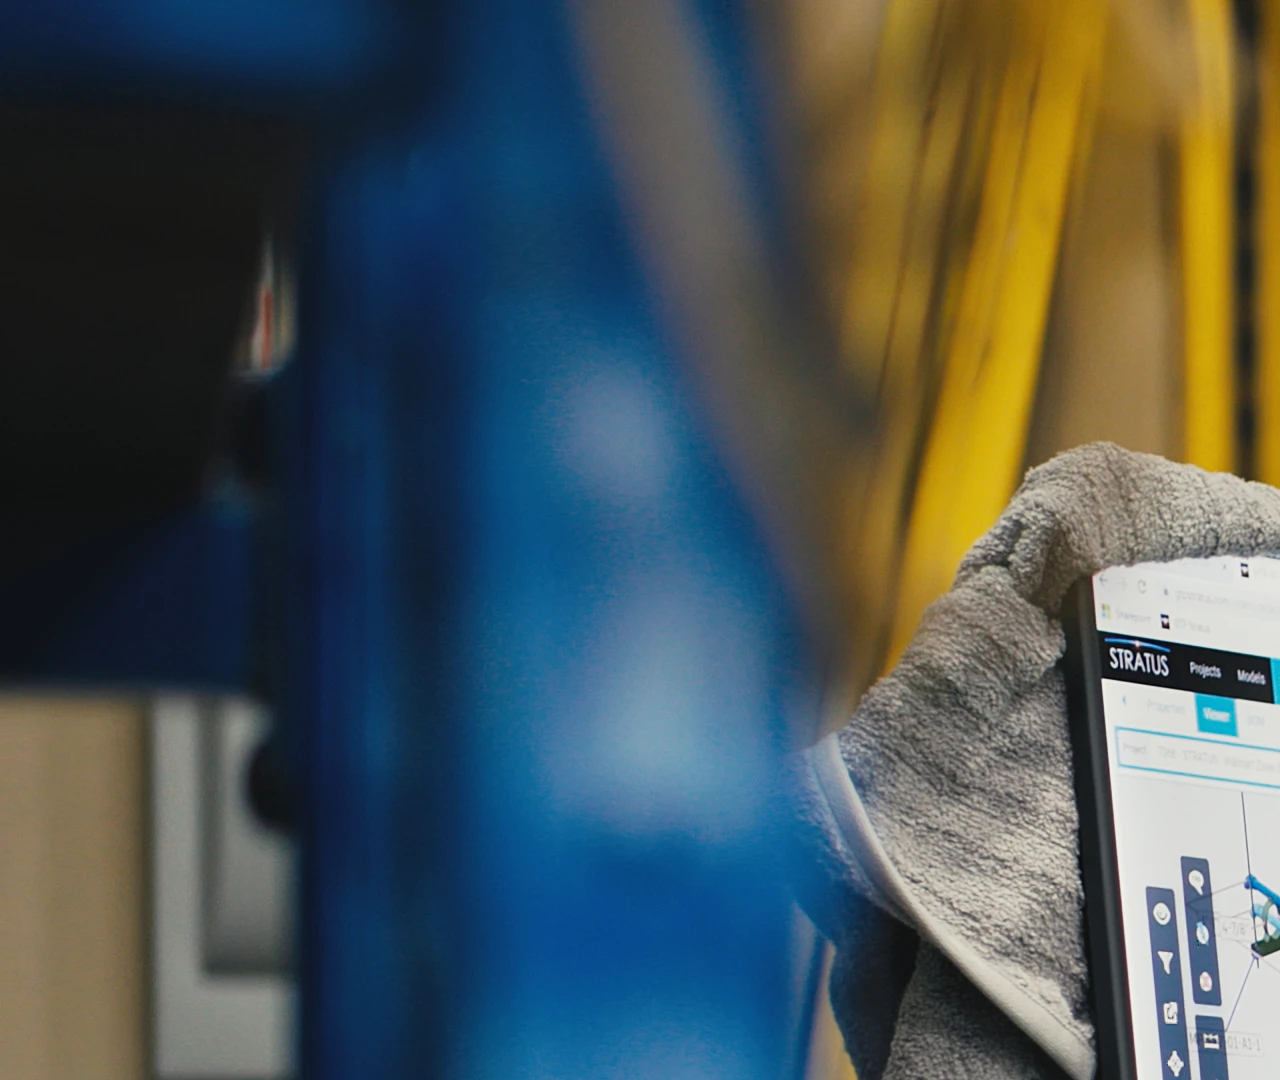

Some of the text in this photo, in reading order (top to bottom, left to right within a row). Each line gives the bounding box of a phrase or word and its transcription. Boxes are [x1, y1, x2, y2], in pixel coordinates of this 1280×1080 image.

[1109, 646, 1170, 677] STRATUS
[1189, 661, 1222, 679] Projects
[1237, 669, 1266, 685] Models
[1202, 706, 1231, 723] Viewer
